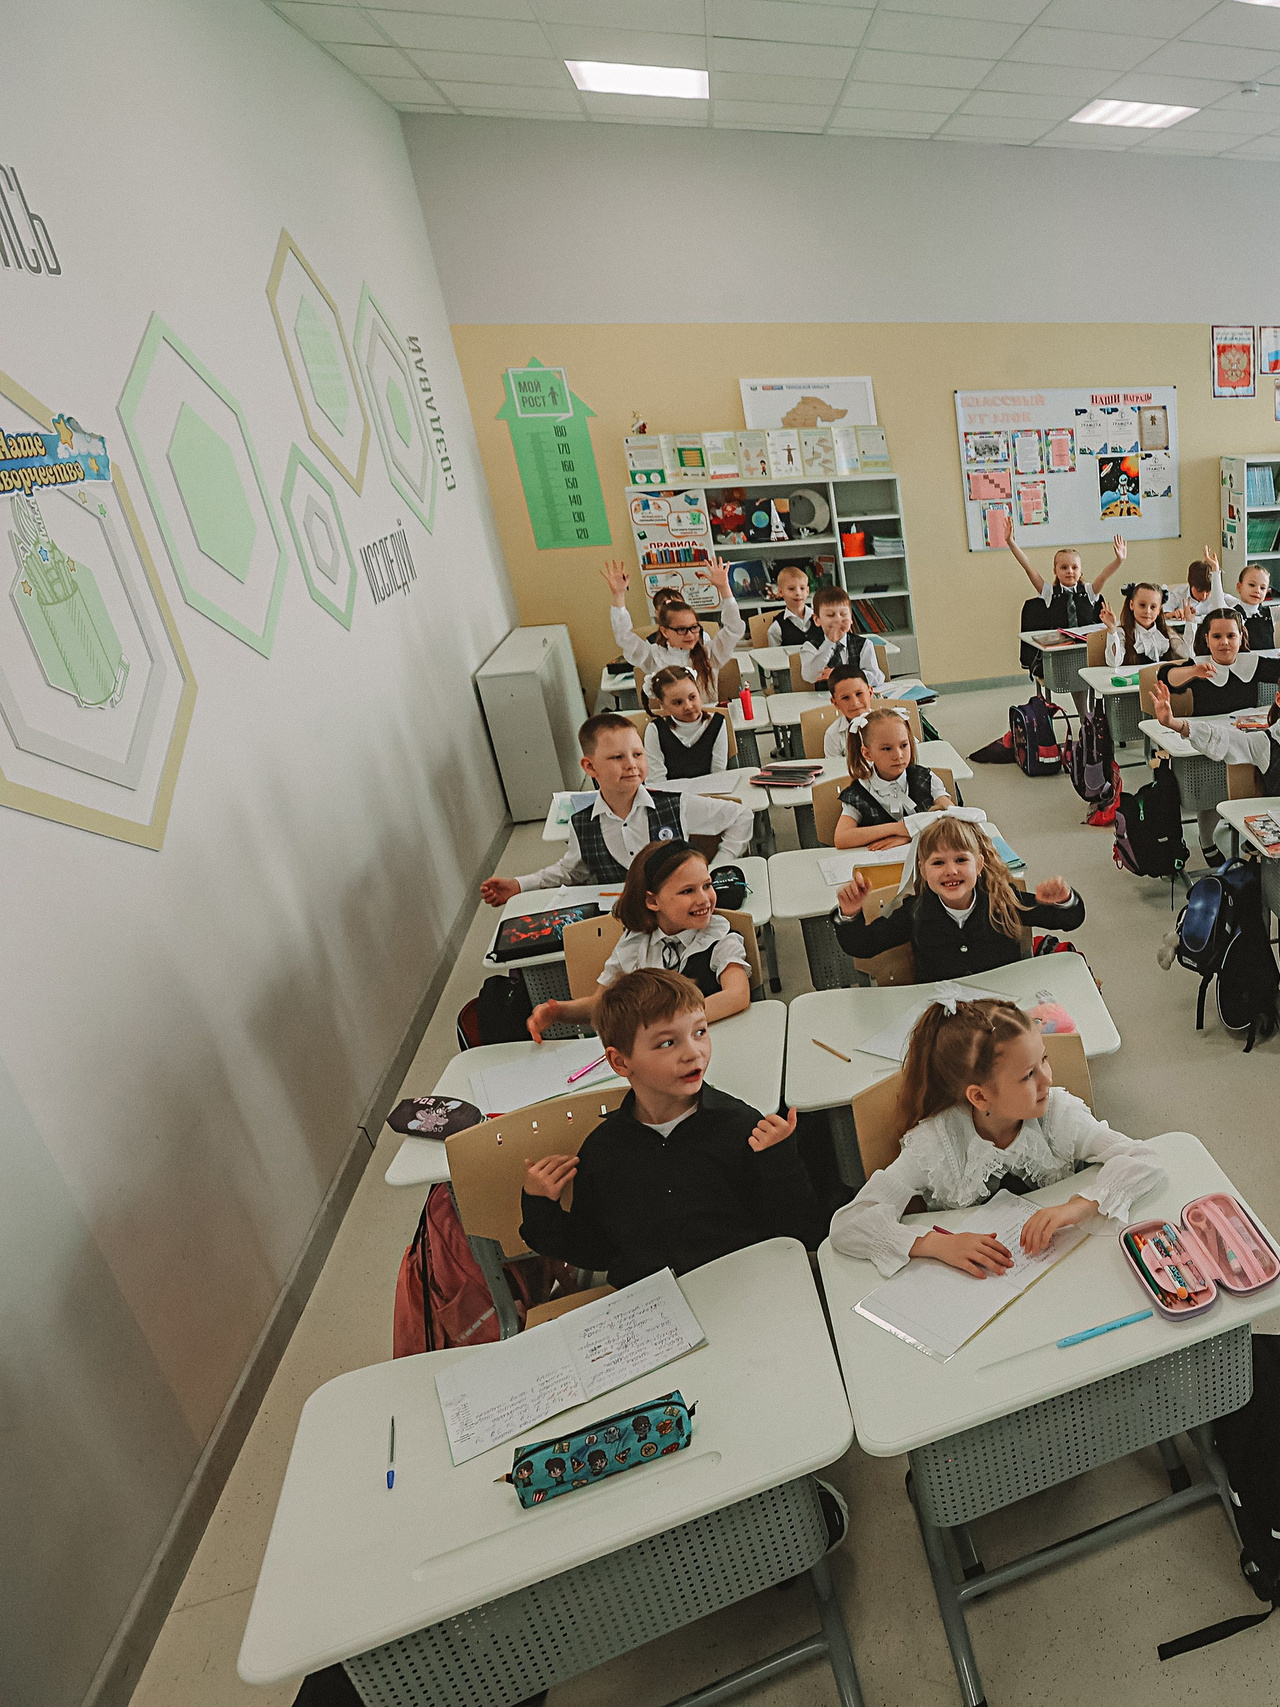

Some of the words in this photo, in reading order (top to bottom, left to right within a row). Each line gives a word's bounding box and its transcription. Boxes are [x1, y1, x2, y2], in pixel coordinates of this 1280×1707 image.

[518, 380, 542, 393] МОЙ
[521, 396, 546, 408] РОСТ
[1091, 394, 1120, 405] НАШИ
[1123, 393, 1152, 402] НАГРАДЫ
[407, 335, 456, 491] СОЗДАВАЙ
[553, 425, 567, 437] 180
[557, 443, 571, 455] 170
[561, 460, 575, 472] 160
[0, 461, 85, 495] ворчество
[564, 477, 578, 489] 150
[568, 494, 582, 506] 140
[572, 511, 585, 523] 130
[575, 528, 589, 540] 120
[649, 540, 698, 549] ПРАВИЛА
[359, 518, 417, 605] ИССЛЕДУЙ
